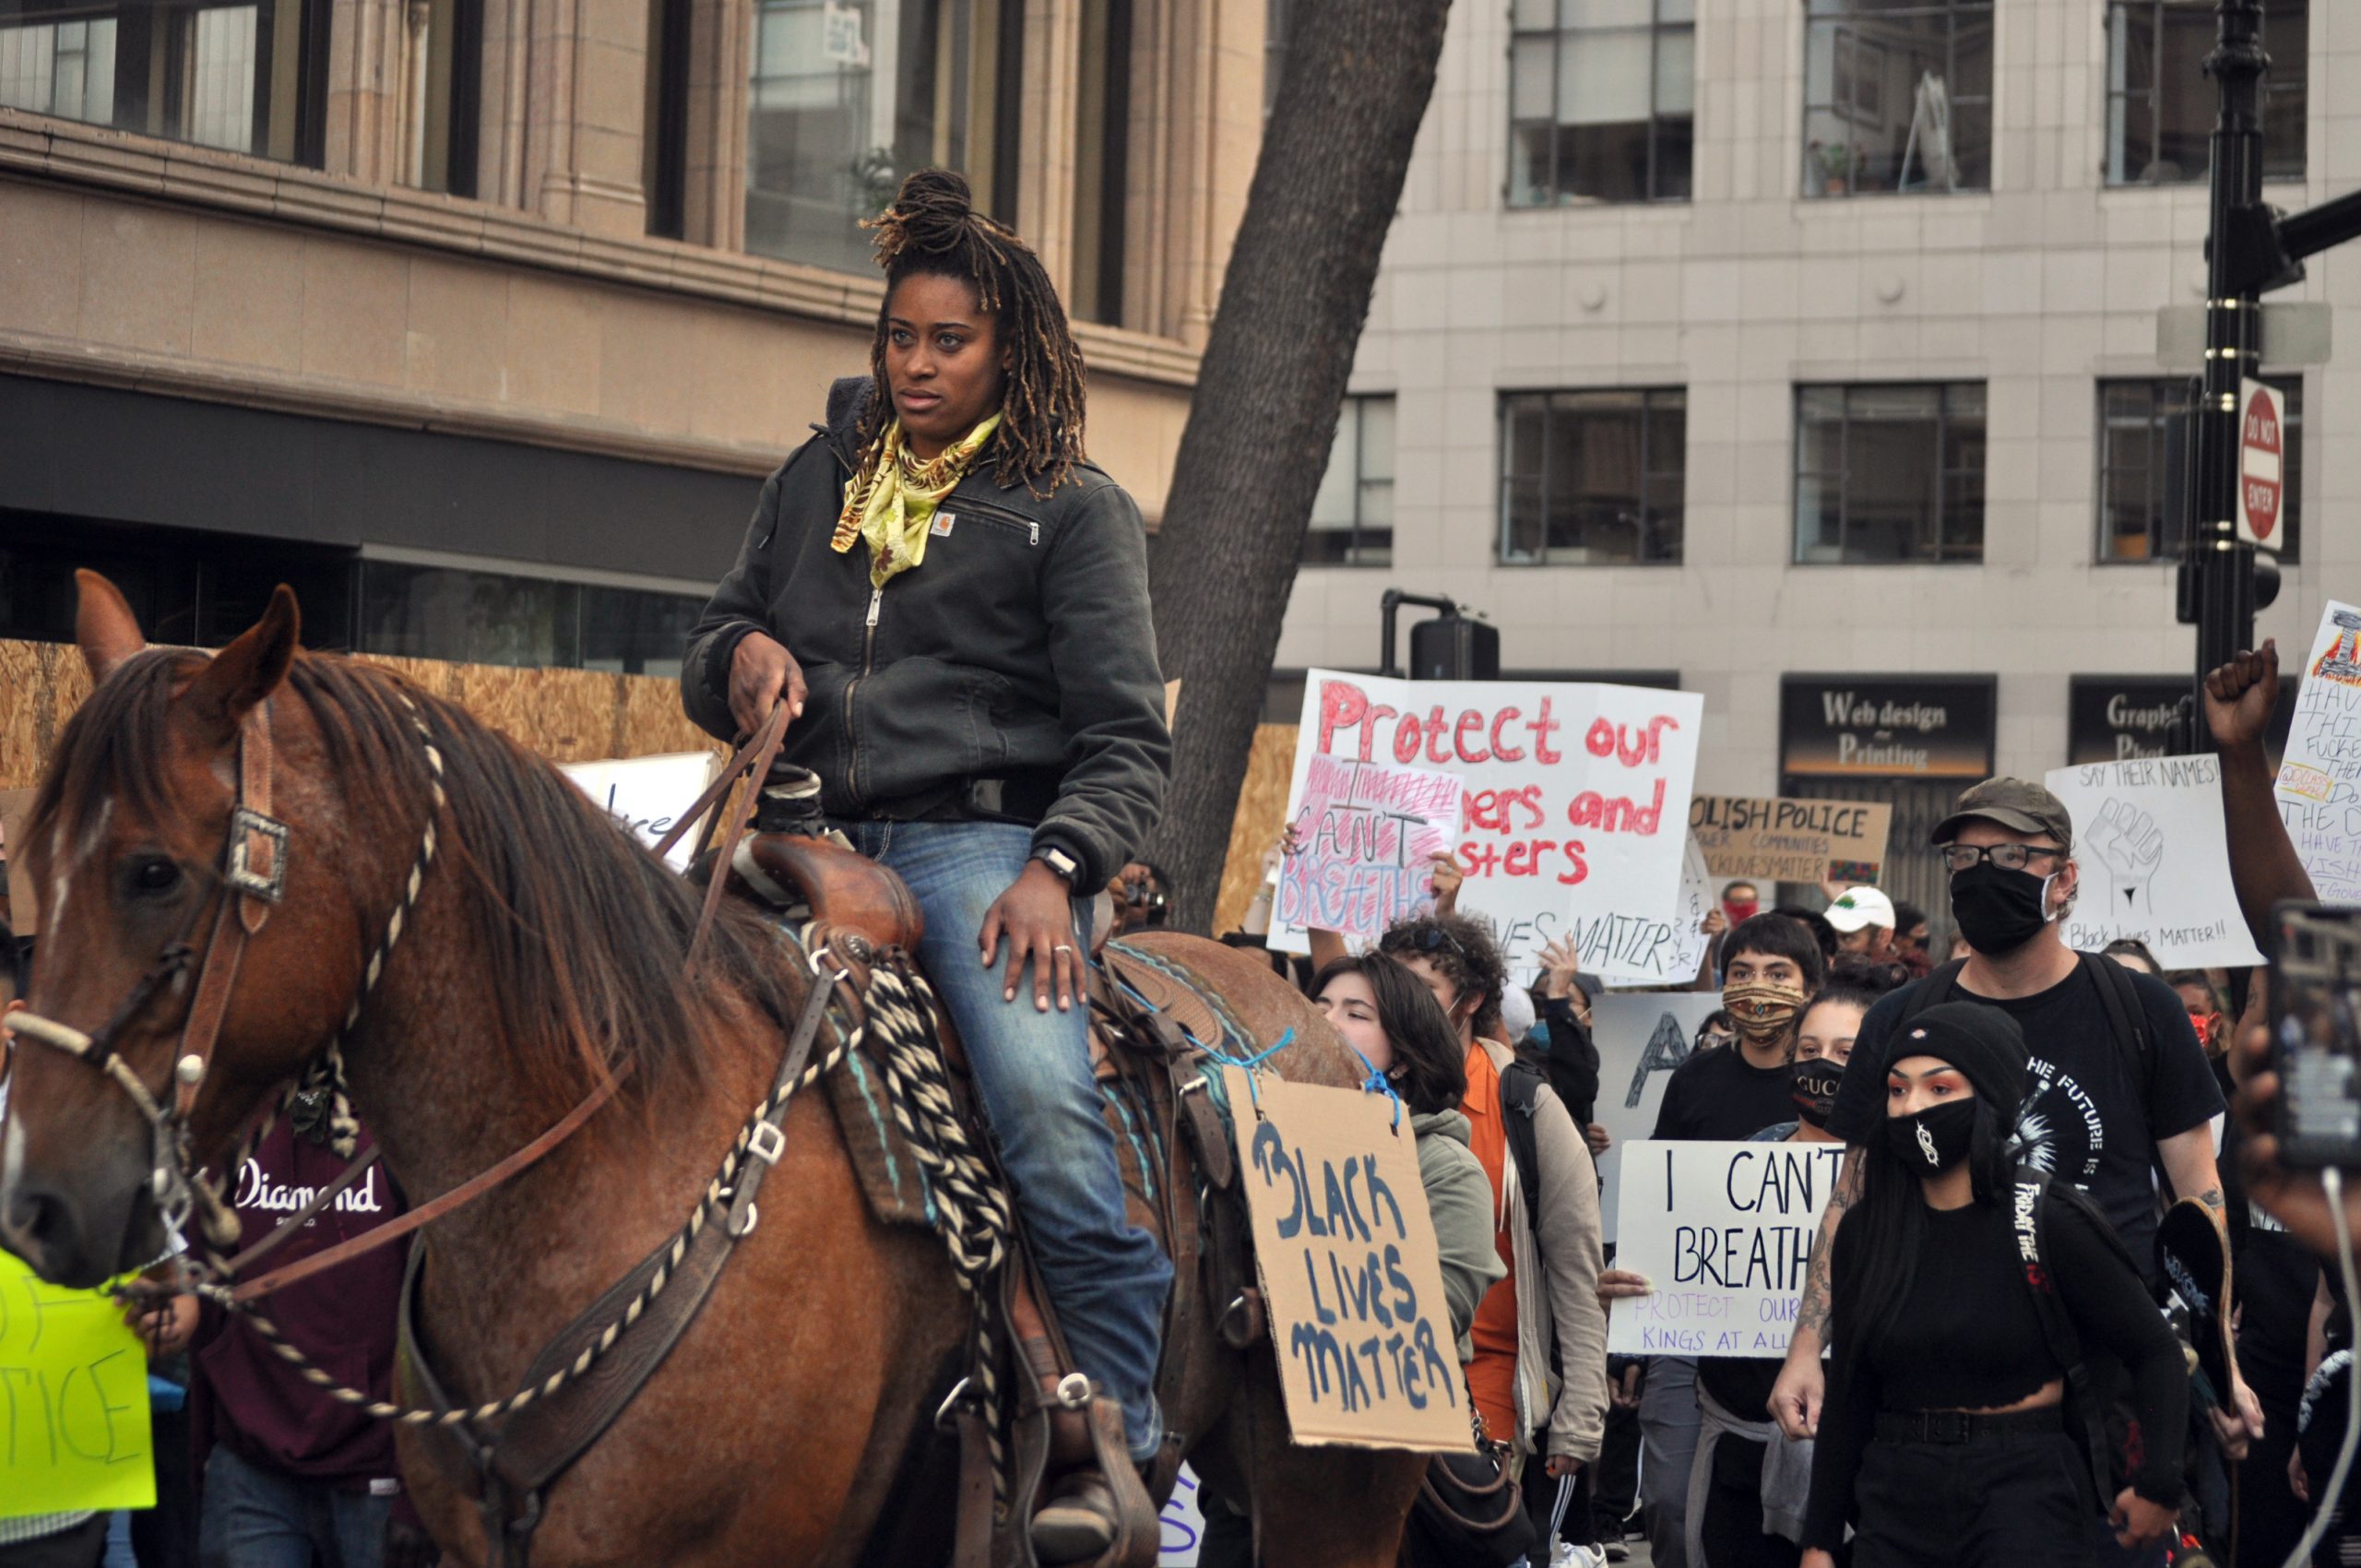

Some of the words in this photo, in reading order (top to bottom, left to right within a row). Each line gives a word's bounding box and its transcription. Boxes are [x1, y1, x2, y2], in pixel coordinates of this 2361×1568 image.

[2248, 414, 2259, 439] DO
[2260, 418, 2275, 445] NOT
[2248, 482, 2273, 514] ENTER
[1318, 679, 1560, 766] Protect
[1586, 715, 1679, 767] our
[1822, 691, 1877, 726] Web
[1880, 699, 1948, 732] design
[1838, 733, 1928, 773] Printing
[2080, 765, 2106, 788] SAY
[2112, 761, 2156, 788] THEIR
[2160, 758, 2222, 788] NAMES!
[1569, 778, 1667, 836] and
[1774, 802, 1869, 837] POLICE
[1572, 911, 1671, 975] MATTER
[2070, 922, 2109, 950] Black
[2160, 919, 2227, 948] MATTER!!
[2057, 1074, 2104, 1152] FUTURE
[1252, 1120, 1406, 1243] BLACK
[1666, 1149, 1673, 1212] I
[1726, 1146, 1845, 1215] CAN'T
[1674, 1226, 1813, 1290] BREATH
[1303, 1242, 1417, 1329] LIVES
[1634, 1289, 1734, 1321] PROTECT
[1759, 1298, 1801, 1323] OUR
[1643, 1325, 1705, 1351] KINGS
[1716, 1331, 1743, 1350] AT
[1753, 1331, 1788, 1350] ALL
